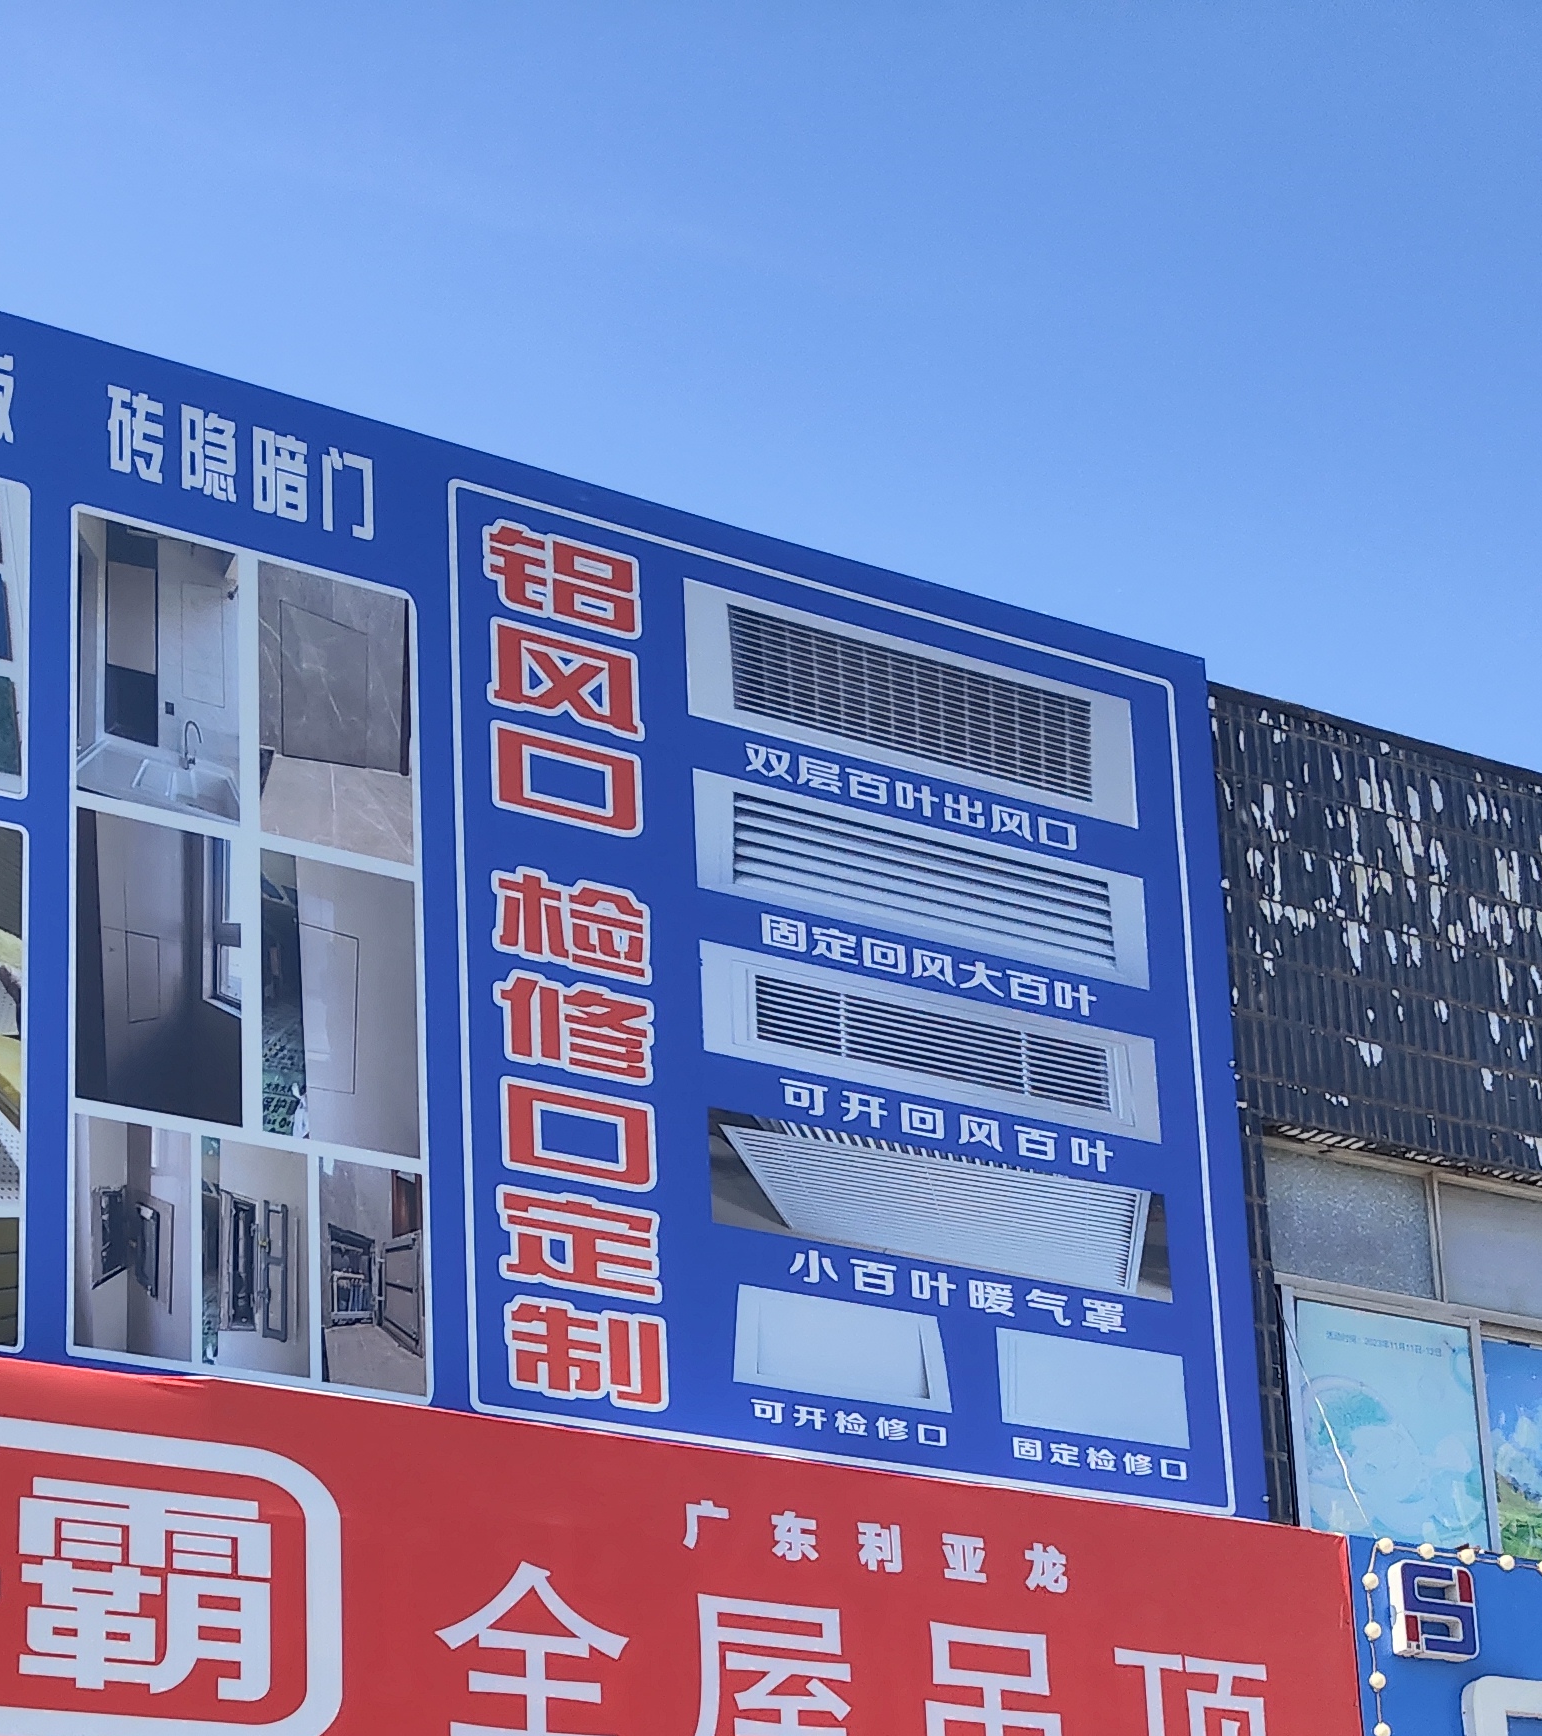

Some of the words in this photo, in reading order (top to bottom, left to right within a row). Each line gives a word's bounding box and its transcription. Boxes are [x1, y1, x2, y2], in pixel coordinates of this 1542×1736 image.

[106, 383, 374, 541] 砖隐暗门
[481, 517, 645, 838] 铝风口
[744, 741, 1079, 853] 双层百叶出风口
[760, 911, 1098, 1018] 固定回风大百叶
[491, 865, 672, 1412] 检修口定制
[779, 1077, 1115, 1174] 可开回风百叶
[789, 1249, 1129, 1336] 小百叶暖气罩
[750, 1398, 949, 1449] 可开检修口
[1011, 1436, 1189, 1482] 固定检修口
[682, 1499, 1070, 1595] 广东利亚龙
